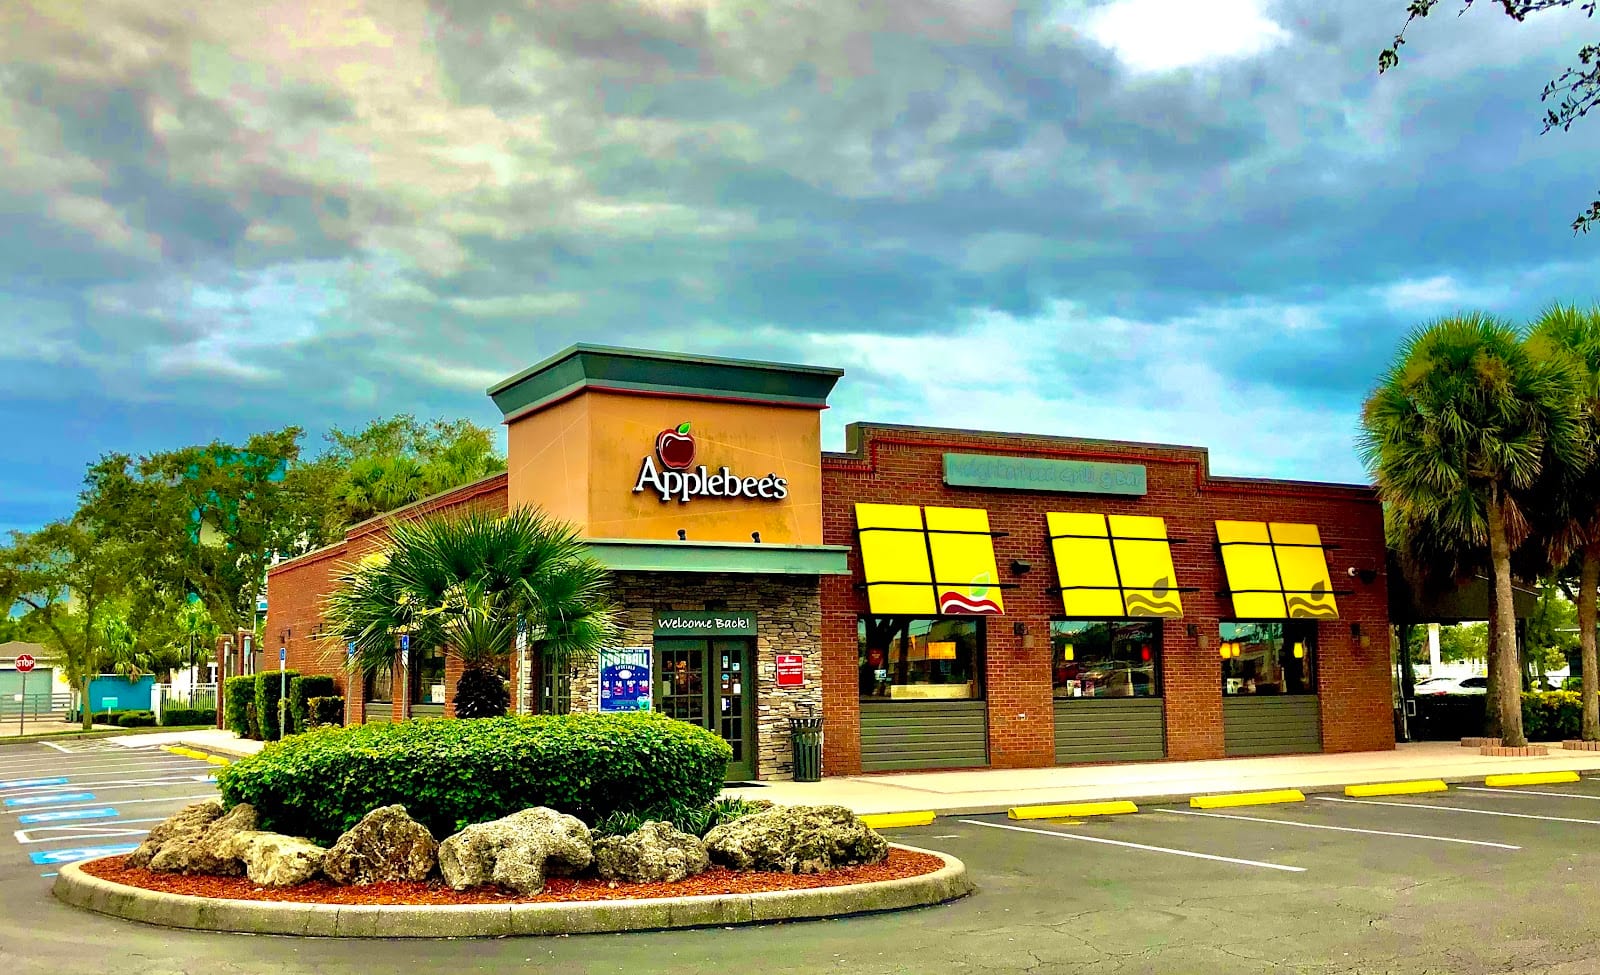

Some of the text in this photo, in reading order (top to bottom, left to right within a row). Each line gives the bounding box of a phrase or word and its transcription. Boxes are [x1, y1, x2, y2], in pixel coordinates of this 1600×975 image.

[633, 455, 788, 502] Applebee's
[1060, 464, 1096, 486] Grill
[1115, 470, 1142, 487] Bar
[658, 617, 749, 629] Welcome Back!
[16, 659, 34, 667] STOP
